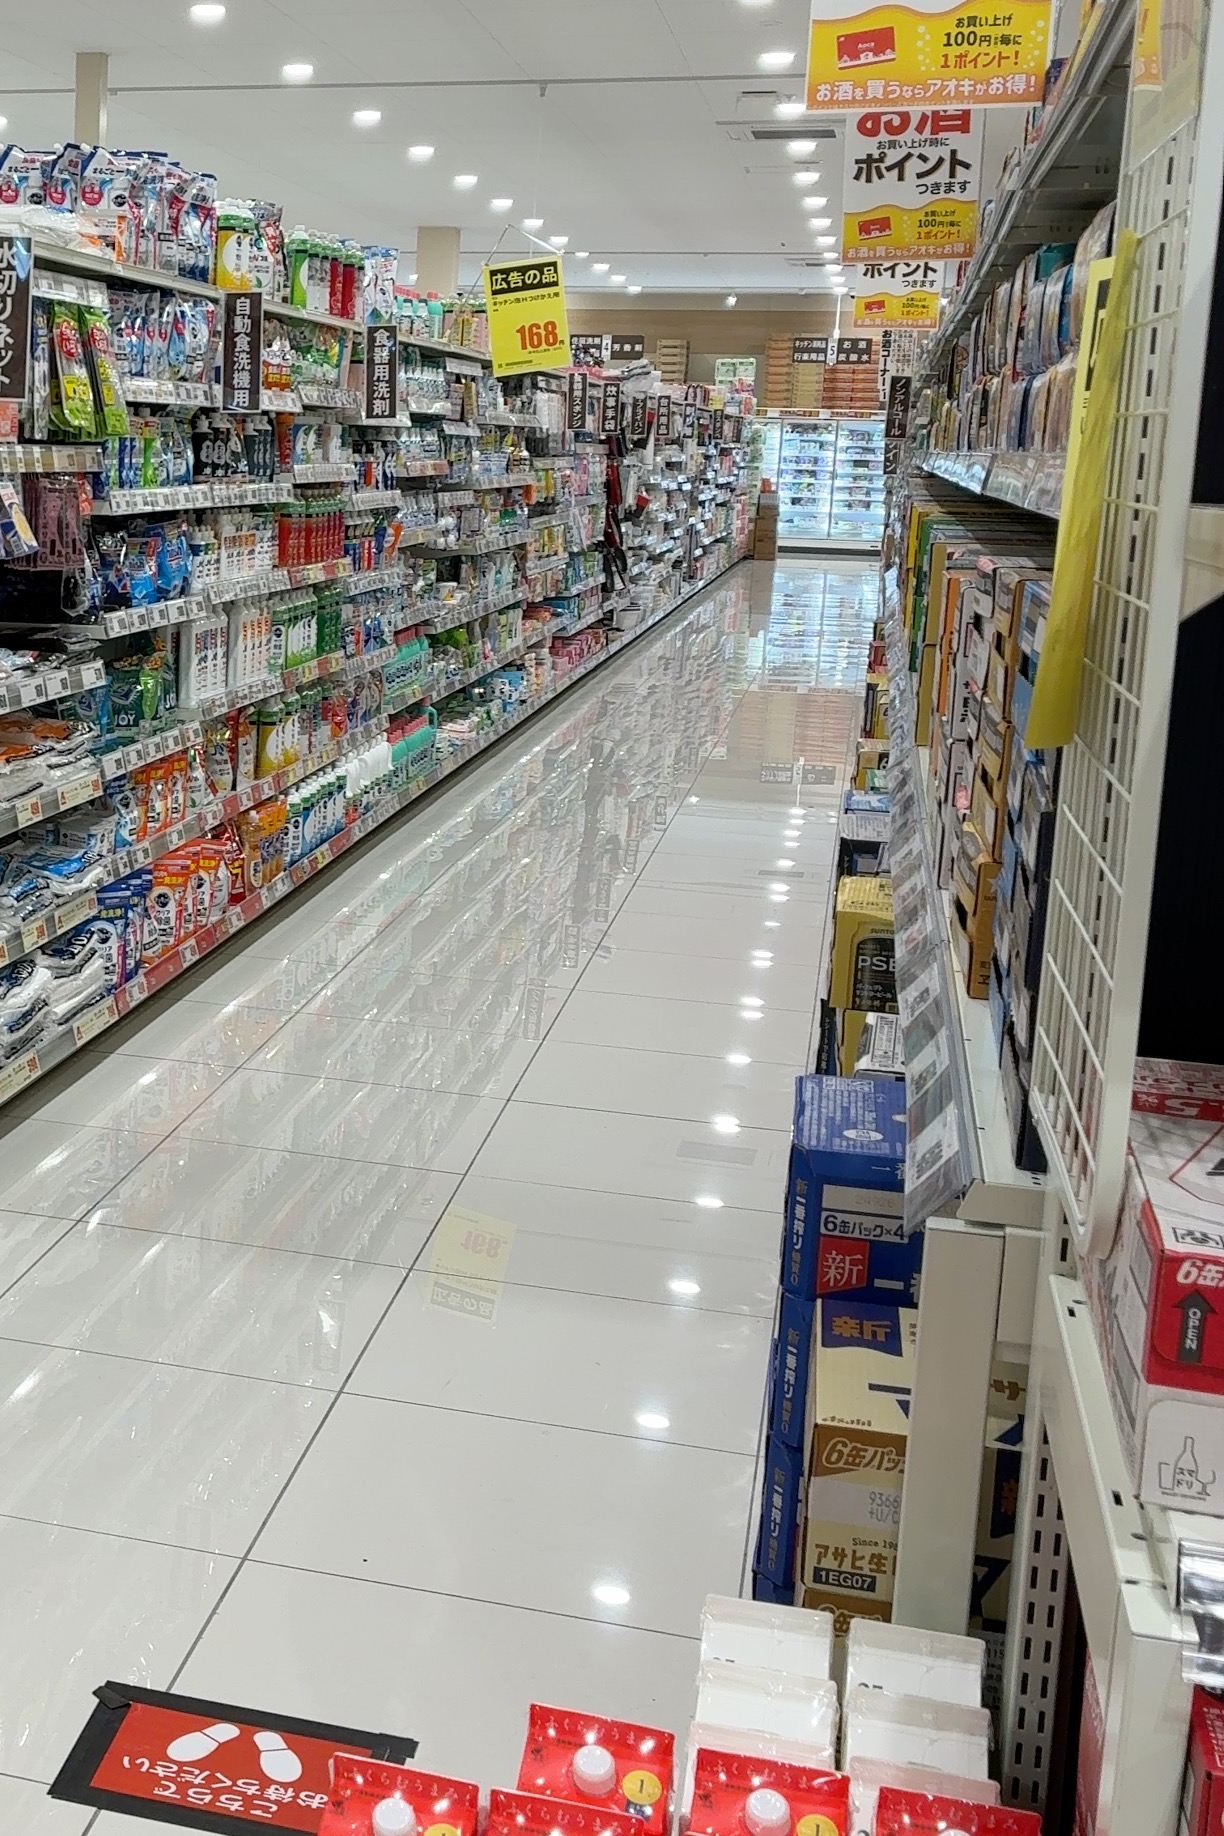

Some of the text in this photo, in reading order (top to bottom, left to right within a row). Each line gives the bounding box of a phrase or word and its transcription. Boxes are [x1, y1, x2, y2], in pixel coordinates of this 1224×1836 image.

[954, 14, 1014, 28] お買い上げ
[876, 137, 950, 151] お買い上げ時に
[853, 148, 973, 184] ポイント
[915, 179, 972, 195] つきます
[491, 266, 558, 291] 広告の品
[901, 279, 937, 289] つきます
[516, 320, 559, 351] 168
[843, 340, 867, 349] お酒
[232, 296, 252, 407] 自動食洗機用
[371, 329, 392, 417] 食器用洗剤
[604, 384, 618, 432] 炊事手袋
[890, 378, 906, 437] ノンアルコール
[113, 712, 137, 728] JOY
[823, 1250, 865, 1287] 新
[1175, 1257, 1224, 1288] 6缶
[1185, 1307, 1202, 1352] OPEN
[852, 1537, 879, 1548] Since
[814, 1544, 897, 1576] アサヒ生
[819, 1570, 873, 1590] 1EG07
[122, 1755, 330, 1809] お待ちください
[152, 1781, 279, 1818] こちらで
